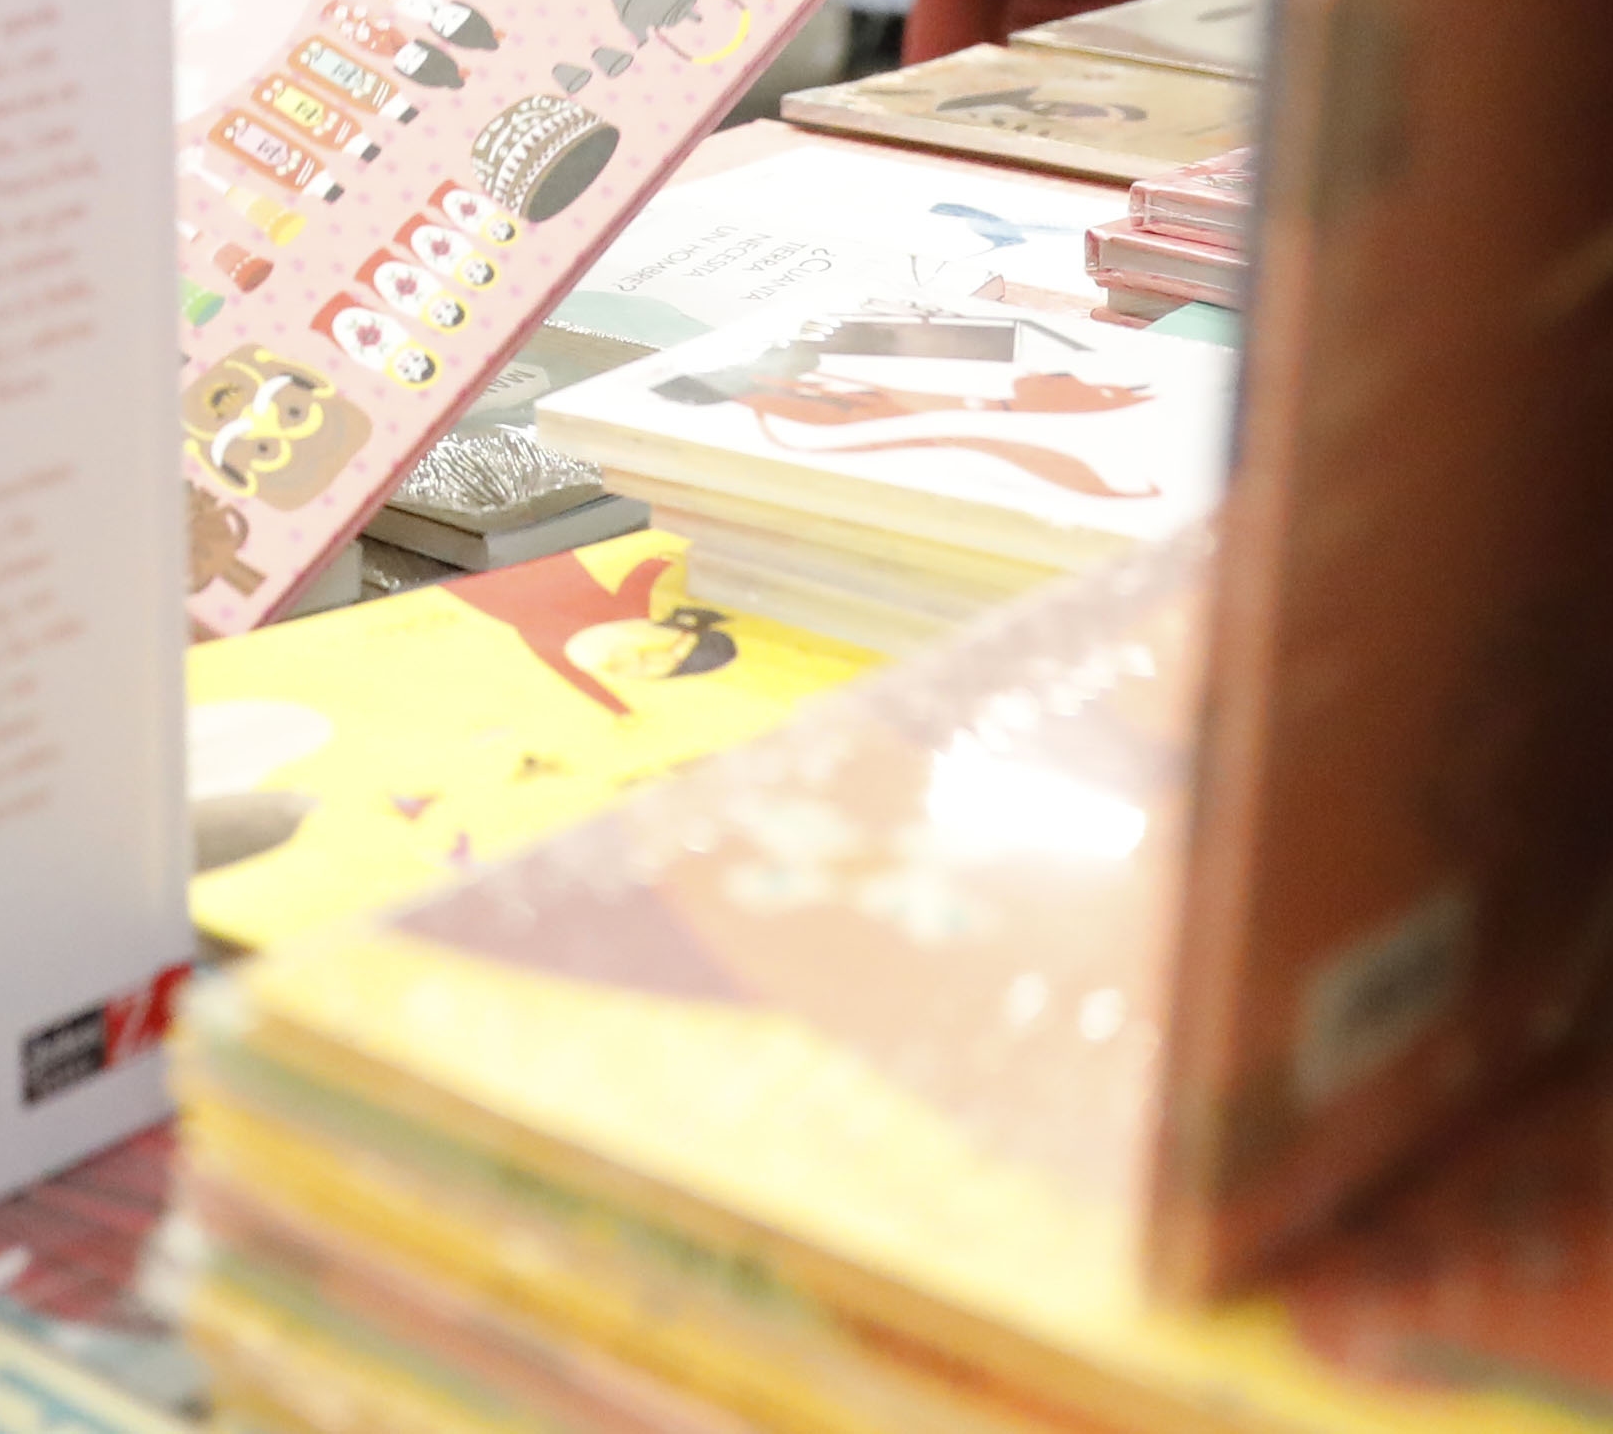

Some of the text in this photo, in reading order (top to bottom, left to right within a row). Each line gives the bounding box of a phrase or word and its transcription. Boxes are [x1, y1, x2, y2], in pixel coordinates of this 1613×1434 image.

[610, 225, 740, 293] UN HOMBRE?
[679, 232, 773, 278] NECESITA
[741, 241, 808, 274] TIERRA
